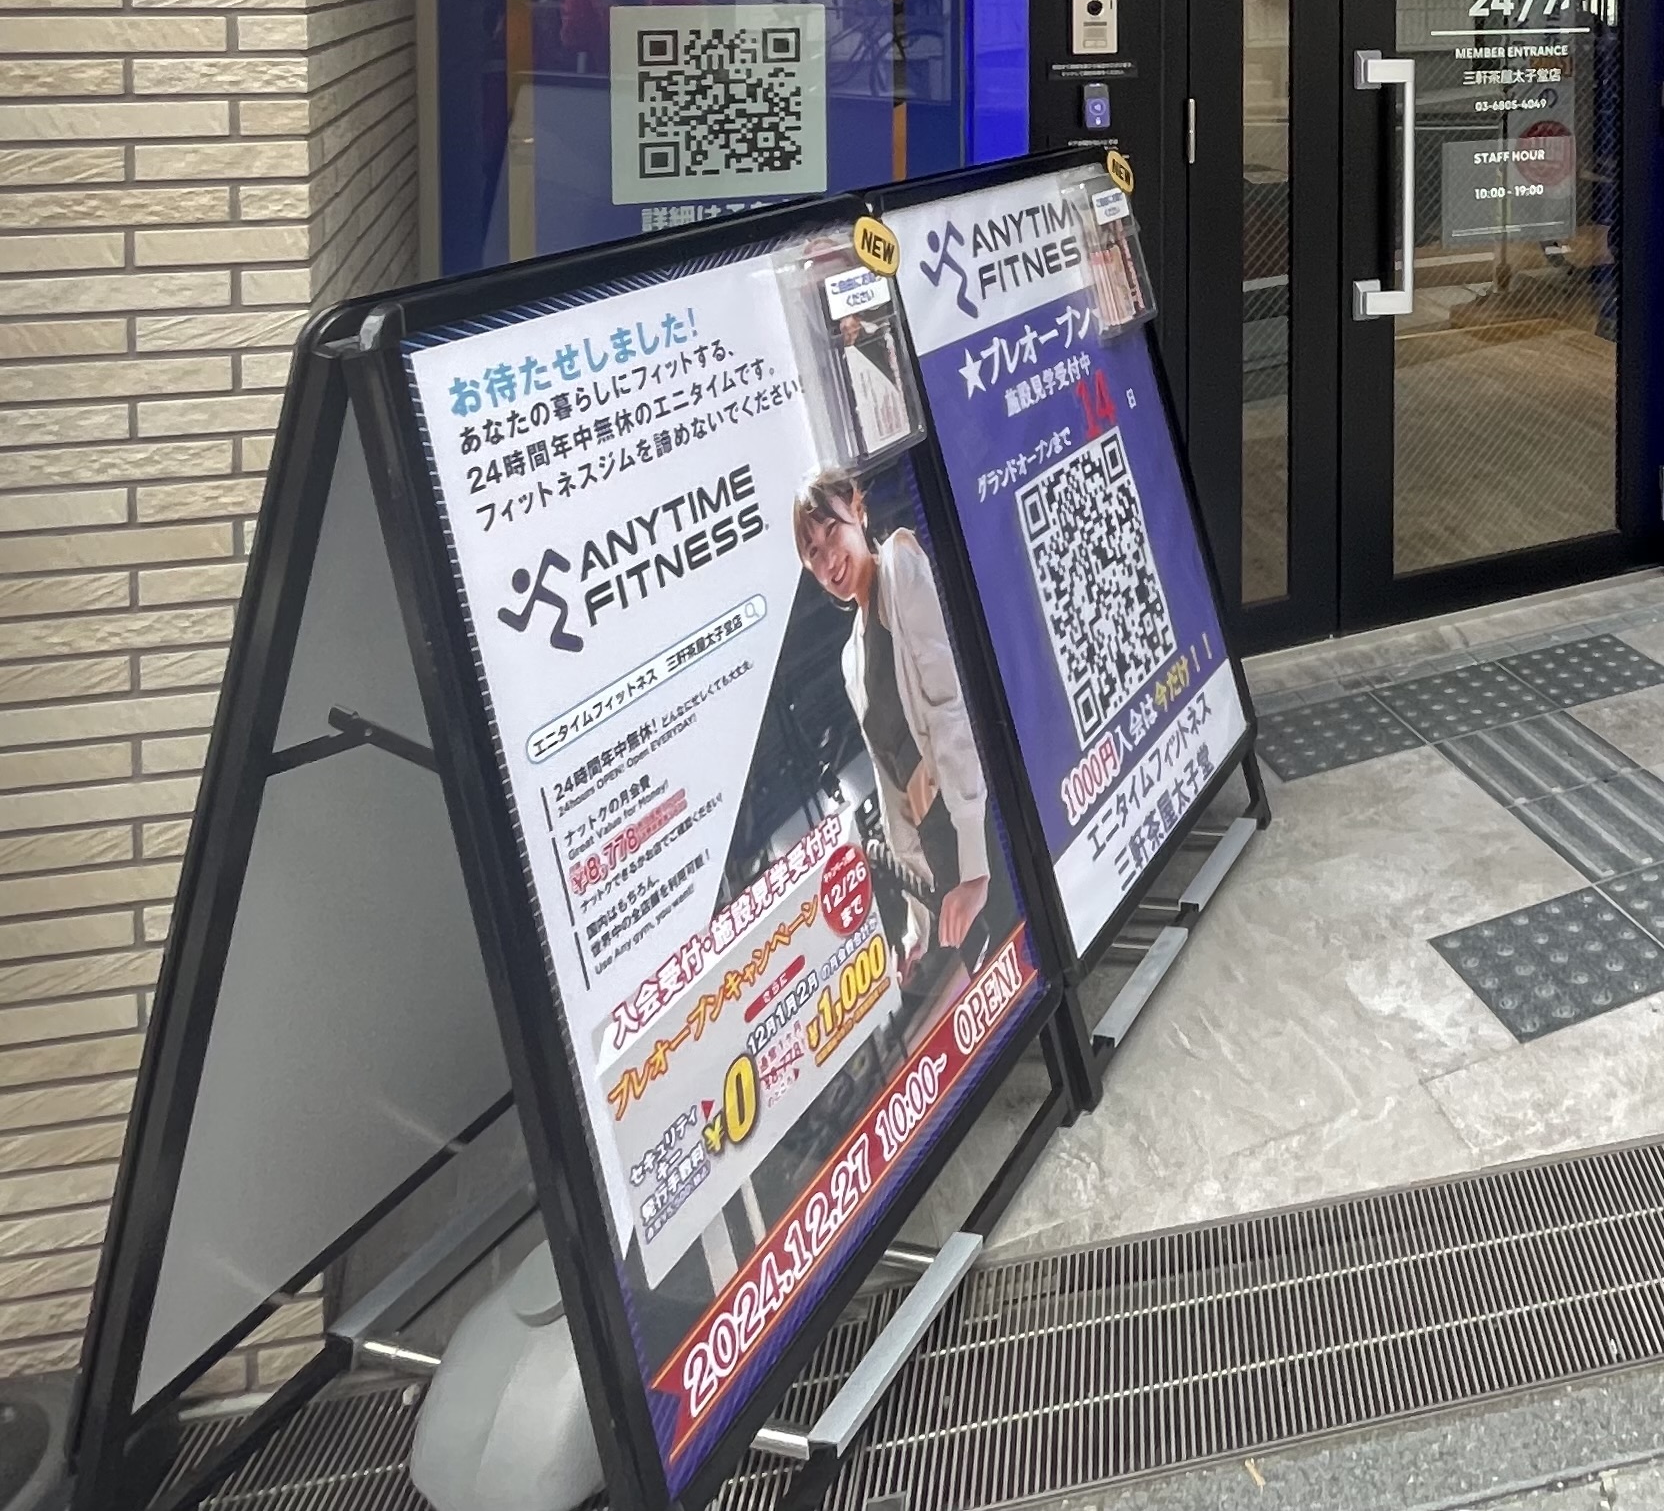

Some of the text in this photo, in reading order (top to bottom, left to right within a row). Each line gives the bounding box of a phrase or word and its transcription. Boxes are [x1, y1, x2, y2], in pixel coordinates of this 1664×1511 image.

[1455, 45, 1569, 59] MEMBER ENTRANCE
[1474, 149, 1545, 165] STAFF HOUR
[1474, 187, 1506, 200] 10:00
[1514, 184, 1544, 197] 19:00
[860, 228, 895, 266] NEW
[972, 198, 1080, 258] ANYTIM
[978, 236, 1082, 300] FITNES
[449, 307, 698, 418] お待たせしました!
[459, 338, 734, 456] あなたの暮らしにフィットする、
[1004, 351, 1092, 418] 施設見学受付中
[466, 357, 776, 495] 24時間年中無休のエニタイムです。
[977, 368, 1137, 504] グランドオープンまで 14 日
[580, 463, 756, 583] ANYTIME
[584, 502, 764, 628] FITNESS
[532, 668, 659, 758] エニタイムフィットネス
[553, 718, 659, 803] 24時間年中無休!
[1087, 691, 1213, 862] エニタイムフィットネス
[612, 813, 843, 1049] 入会受付・施設見学受付中
[822, 862, 867, 915] 12/26
[840, 898, 865, 928] まで
[606, 893, 820, 1122] プレオープンキャンペーン
[762, 974, 788, 1006] さらに
[805, 932, 887, 1052] ¥1,000
[630, 1104, 698, 1188] セキュリティ
[701, 1051, 761, 1157] ¥0
[656, 1148, 683, 1183] キー
[682, 1132, 875, 1418] 2024.12.27
